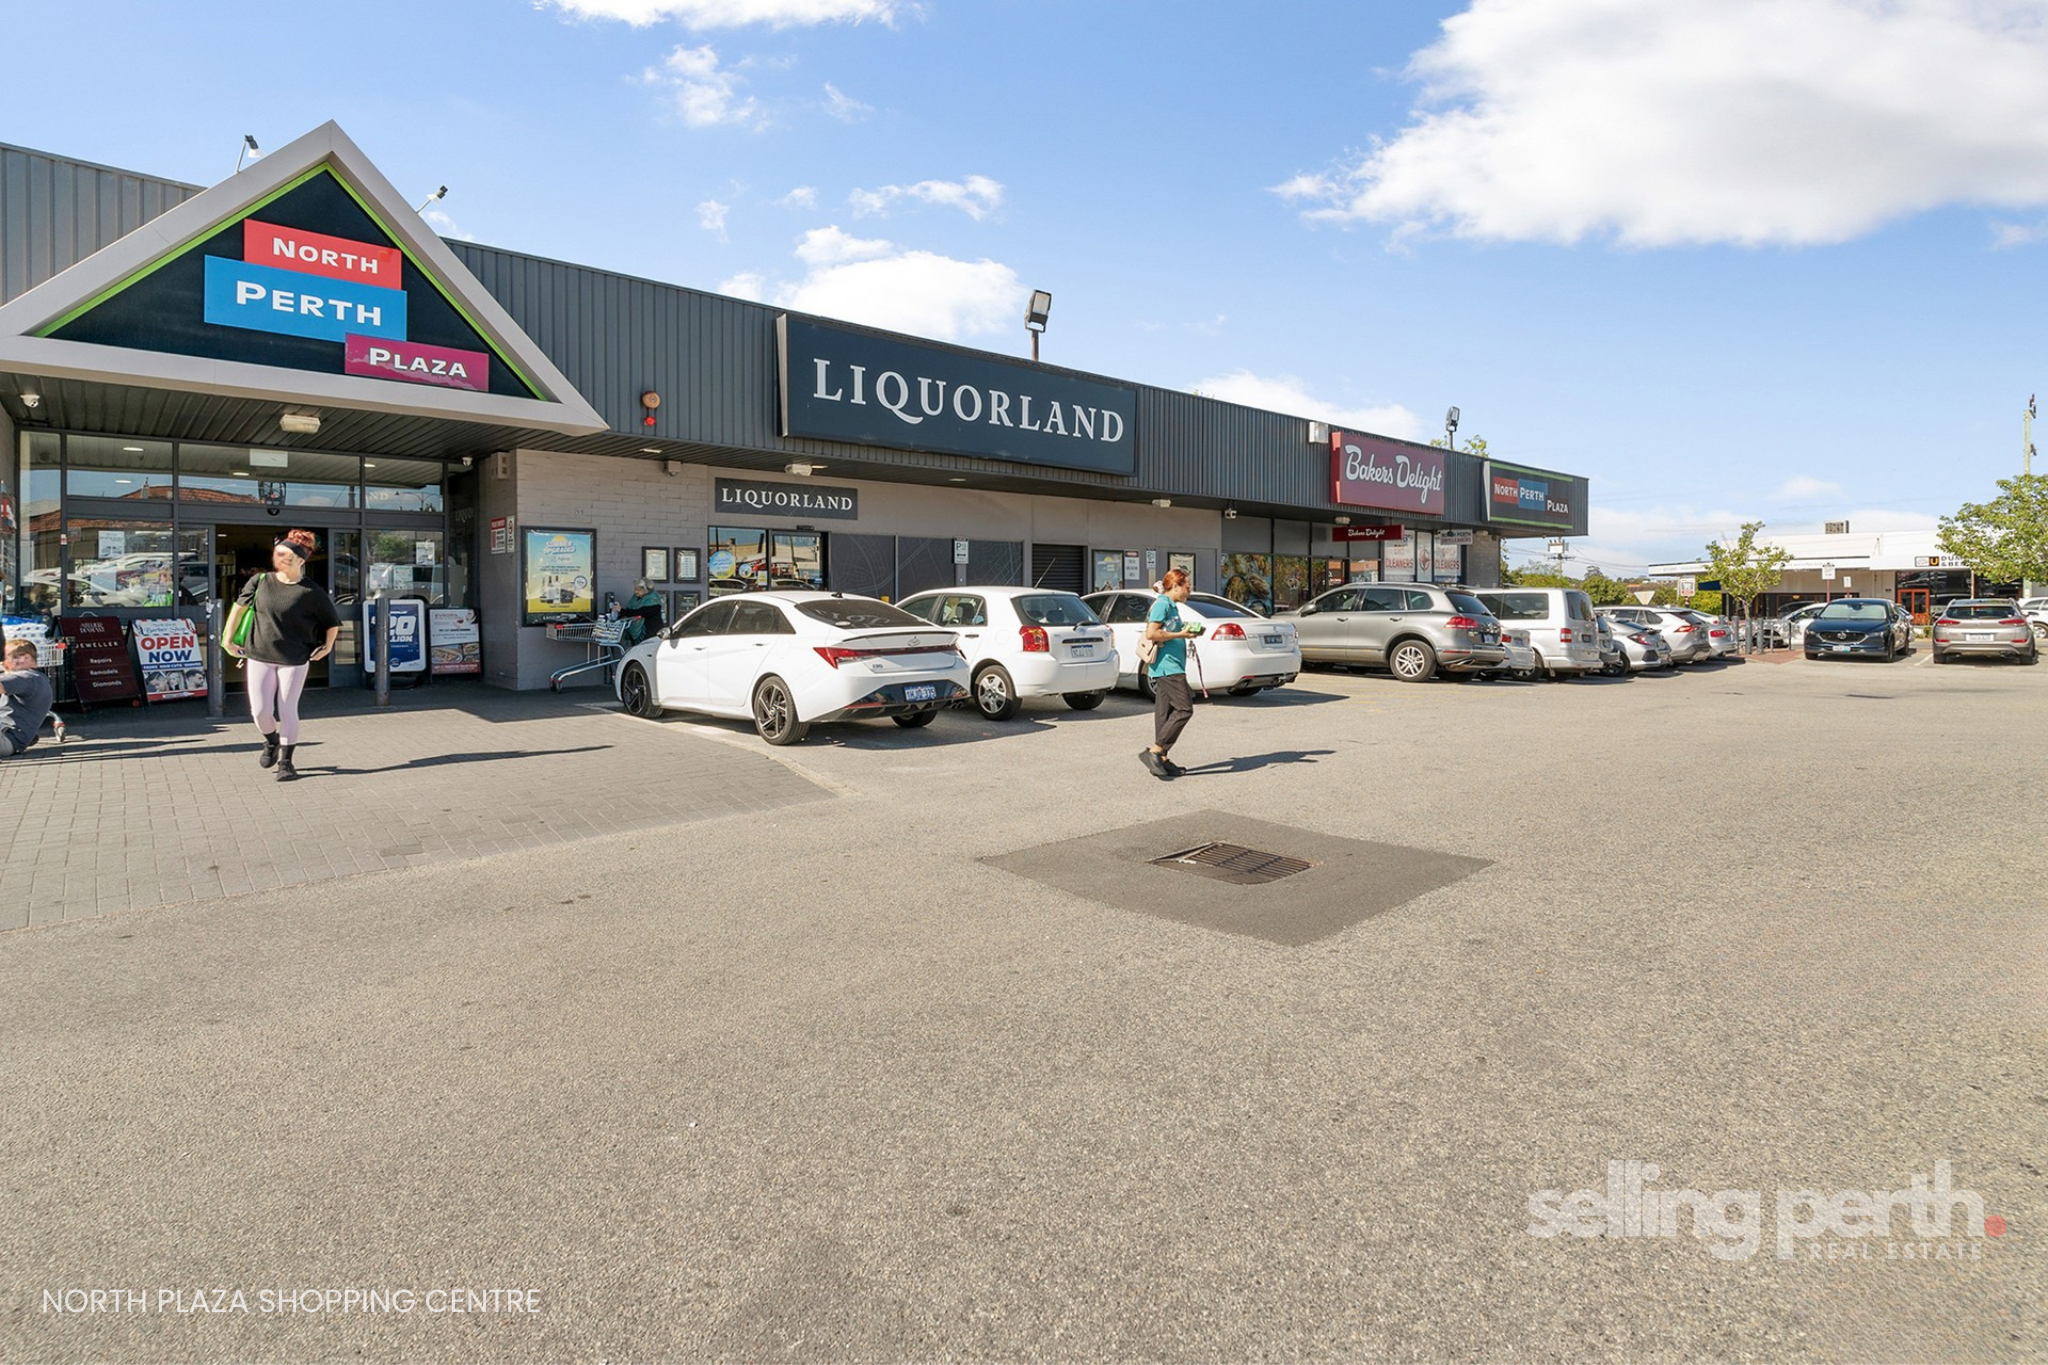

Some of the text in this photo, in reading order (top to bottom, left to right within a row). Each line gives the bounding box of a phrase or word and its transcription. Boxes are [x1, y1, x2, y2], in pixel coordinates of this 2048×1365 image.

[272, 237, 378, 274] NORTH
[236, 280, 382, 327] PERTH
[369, 347, 467, 378] PLAZA
[813, 358, 1124, 442] LIQUORLAND
[1345, 444, 1442, 503] Bakers Delight
[721, 488, 853, 511] LIQUORLAND
[1494, 483, 1569, 514] NORTH PERTH PLAZA
[1347, 528, 1385, 538] Bakers Delight
[1386, 557, 1413, 568] CLEANERS
[1435, 559, 1459, 570] CLEANERS
[76, 641, 119, 649] JEWELLER
[141, 635, 194, 651] OPEN
[149, 650, 192, 663] NOW
[92, 680, 122, 688] Diamonds
